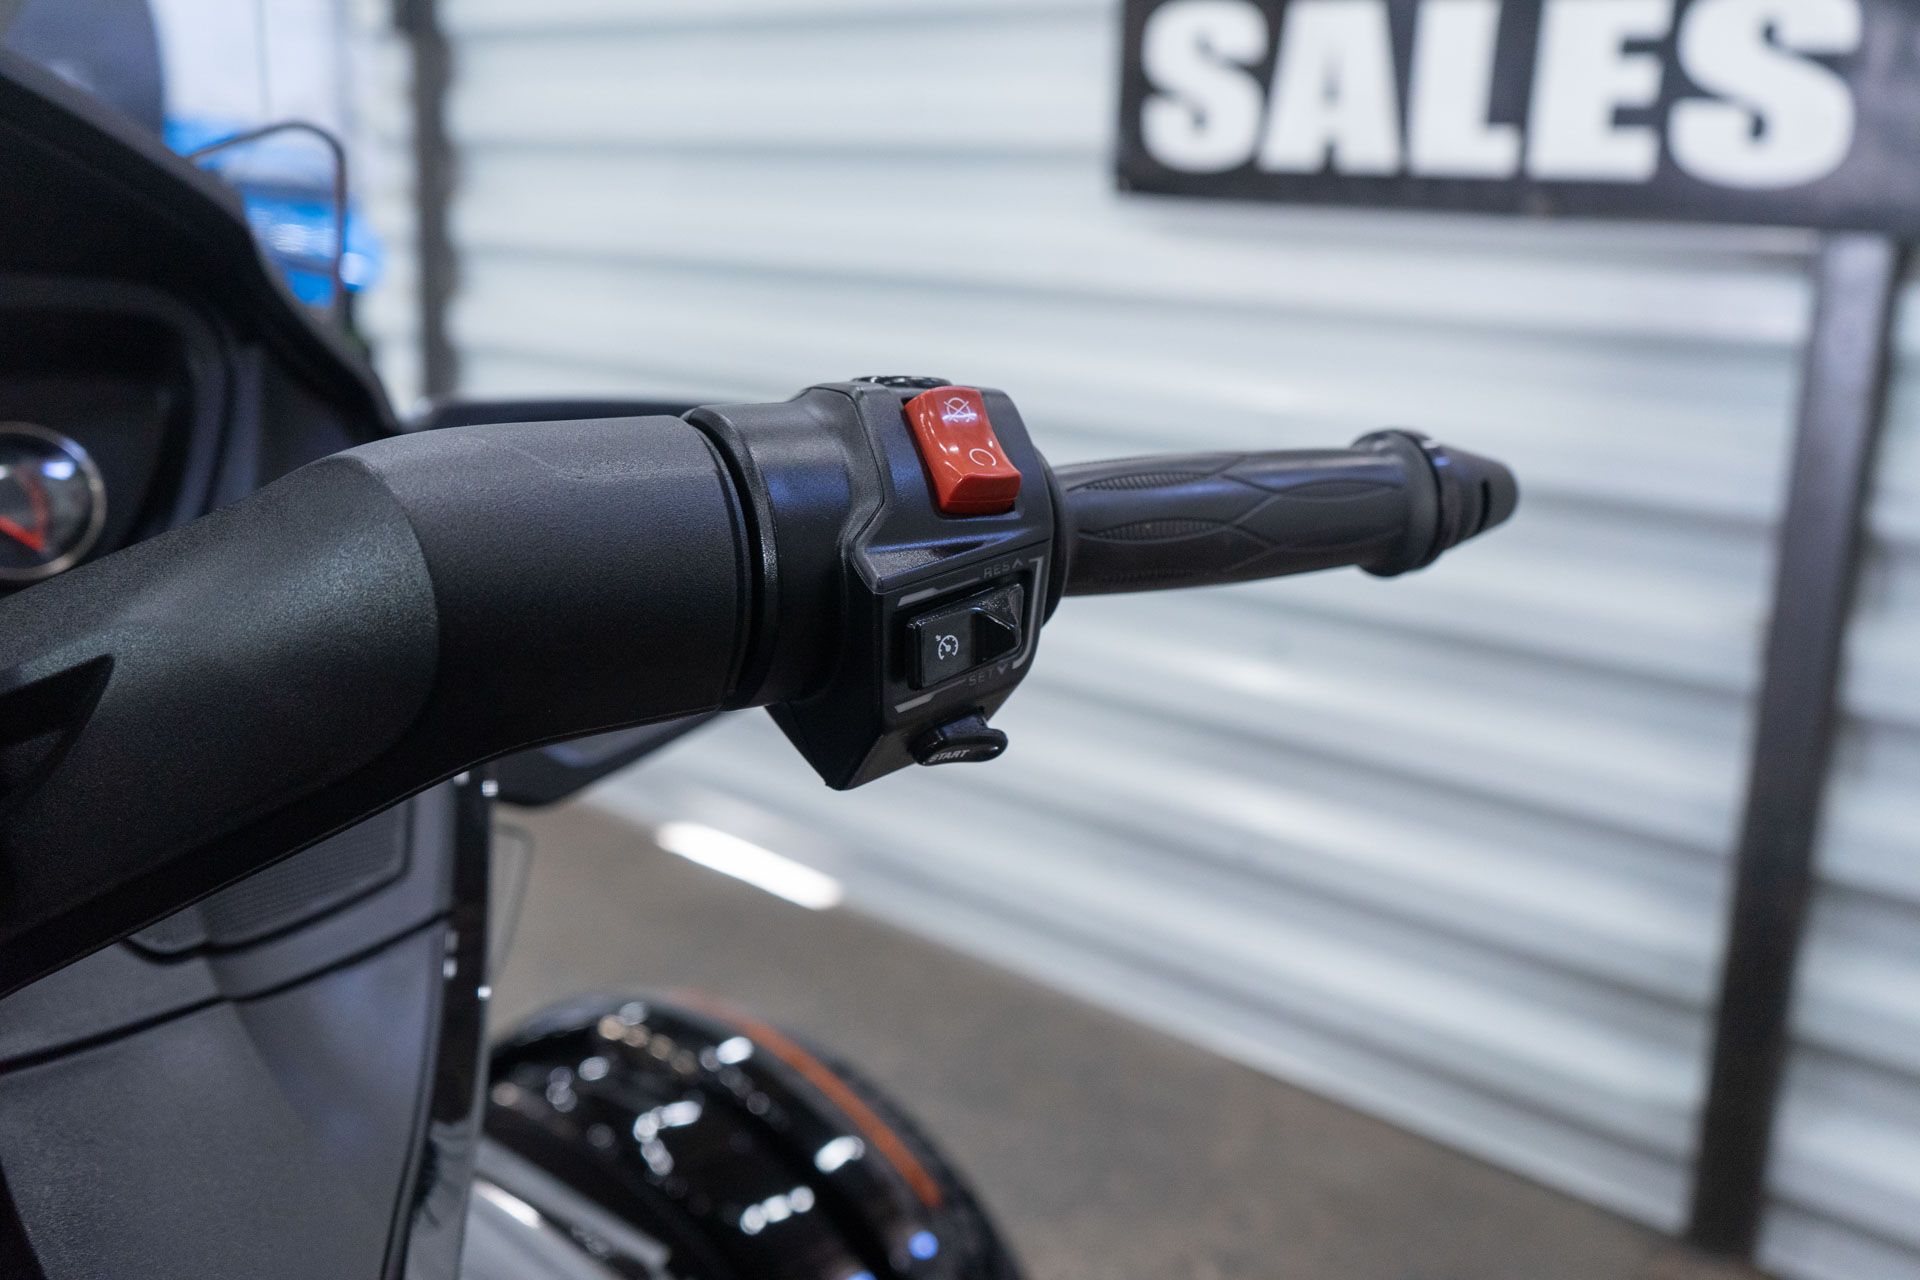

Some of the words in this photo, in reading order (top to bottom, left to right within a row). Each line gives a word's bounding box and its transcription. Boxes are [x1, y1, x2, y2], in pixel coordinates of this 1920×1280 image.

[1140, 0, 1862, 190] SALES
[983, 563, 1011, 579] RES
[968, 668, 993, 686] SET
[929, 749, 970, 762] START
